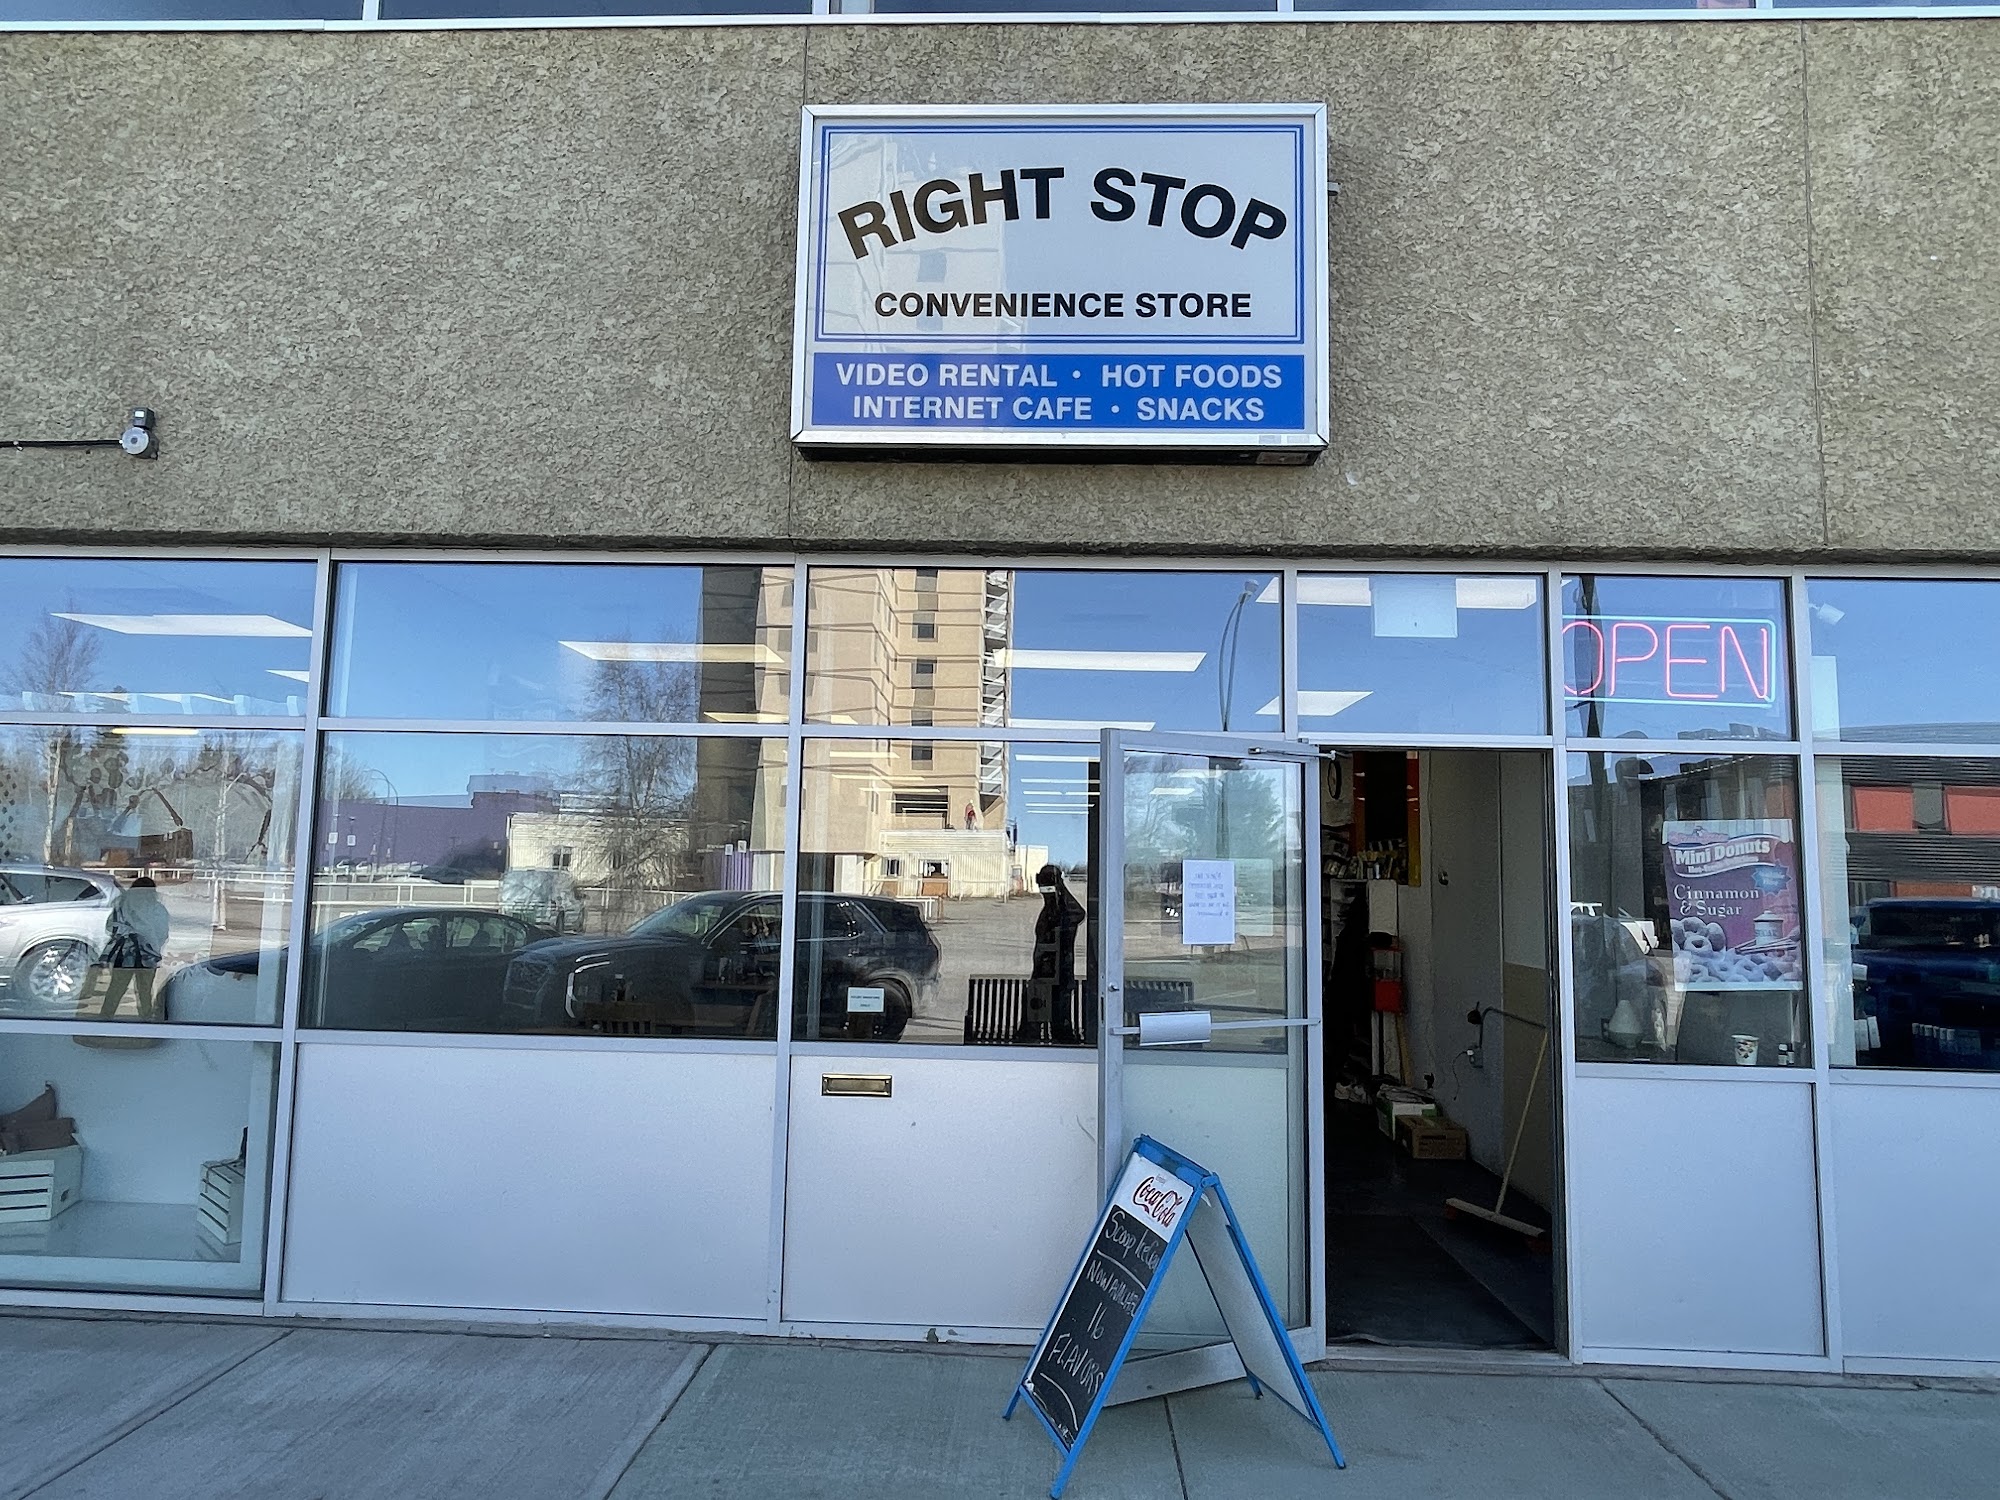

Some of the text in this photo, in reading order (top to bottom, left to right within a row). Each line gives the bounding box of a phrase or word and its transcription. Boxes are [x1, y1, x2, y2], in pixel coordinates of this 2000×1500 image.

[838, 168, 1287, 259] RIGHT STOP
[875, 292, 1251, 318] CONVENIENCE STORE
[836, 362, 1282, 388] VIDEO RENTAL HOT FOODS
[853, 395, 1264, 421] INTERNET CAFE SNACKS
[1562, 621, 1768, 699] OPEN
[1675, 840, 1770, 865] Mini Donuts
[1674, 884, 1760, 900] Cinnamon
[1680, 900, 1742, 917] & Sugar
[1105, 1210, 1136, 1258] Scoop
[1087, 1302, 1104, 1340] 16
[1047, 1333, 1104, 1402] FLAVORS
